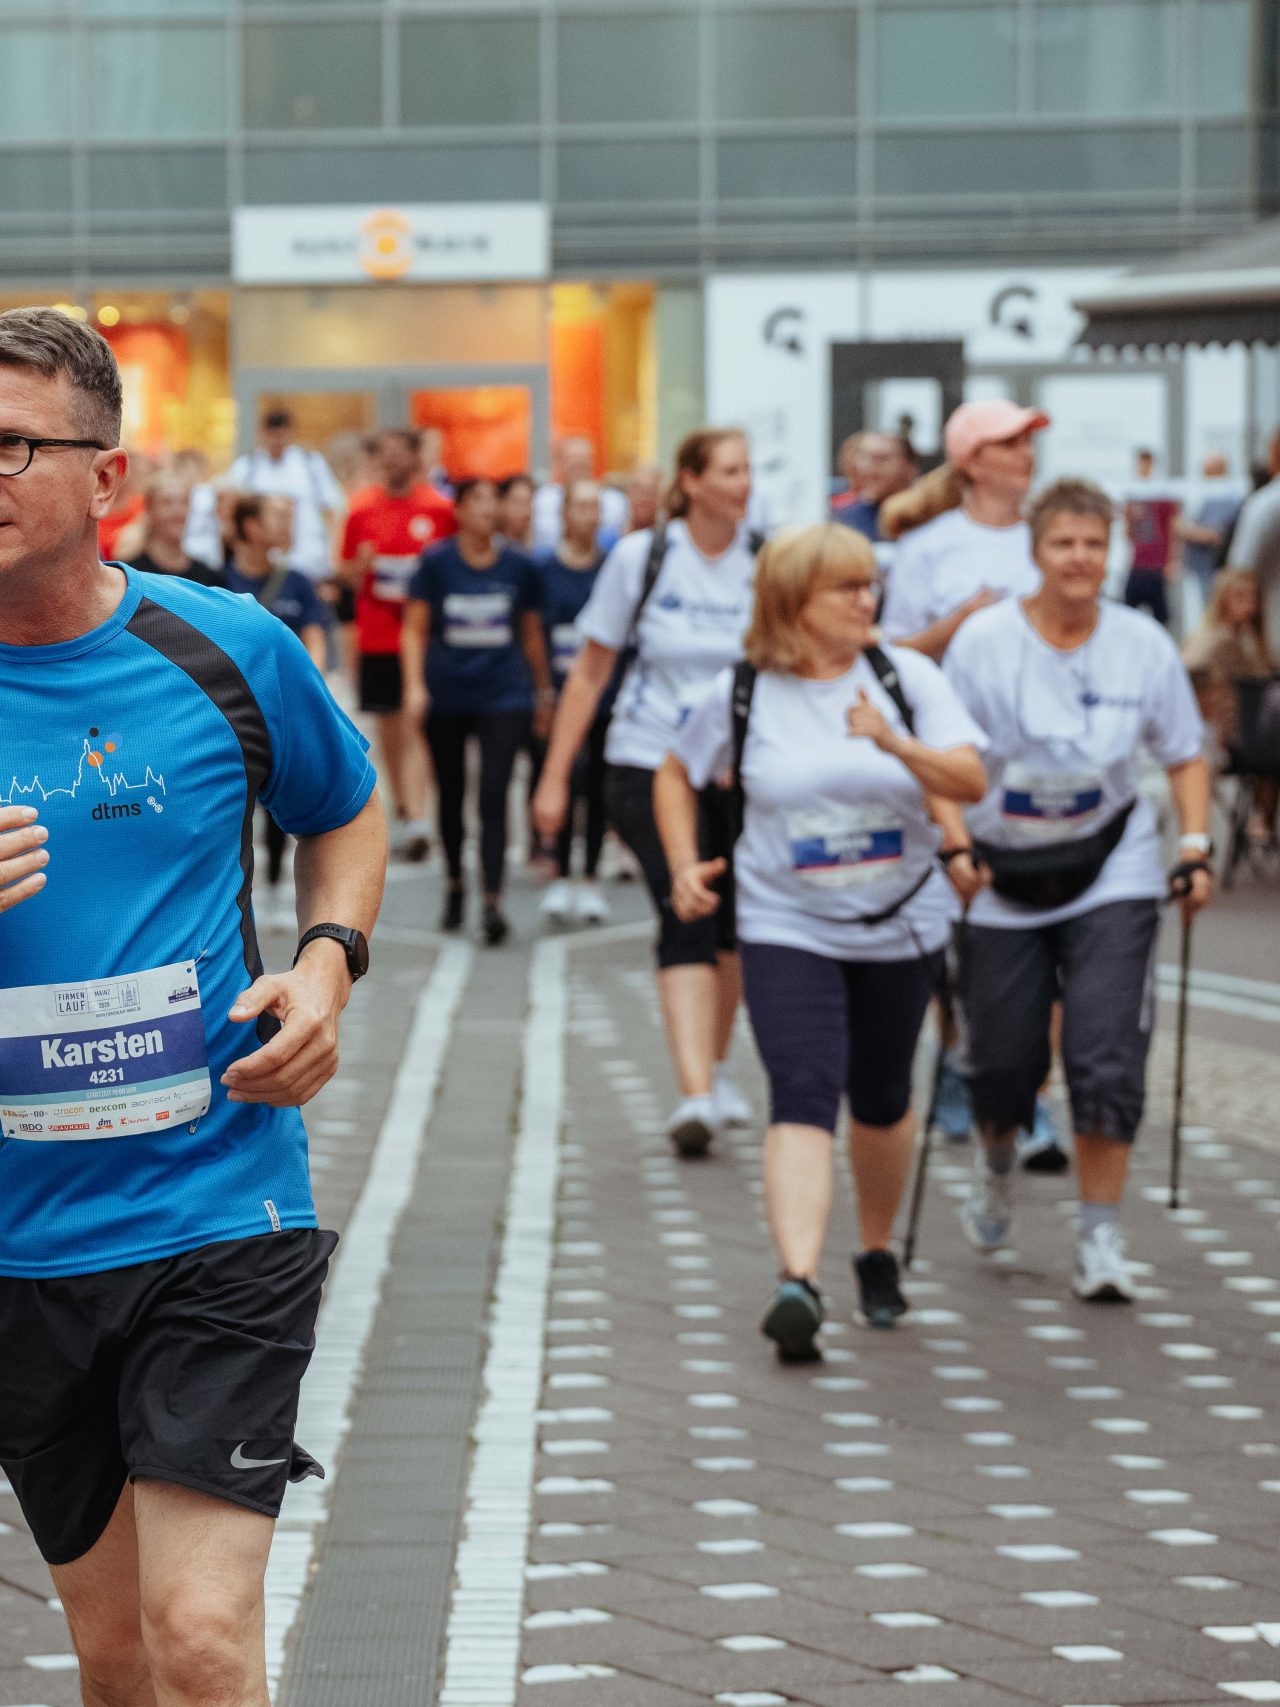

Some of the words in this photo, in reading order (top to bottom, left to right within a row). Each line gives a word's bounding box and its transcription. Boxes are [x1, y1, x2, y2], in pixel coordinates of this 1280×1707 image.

[91, 802, 141, 820] dtms
[58, 991, 85, 1001] FIRMEN
[94, 988, 111, 997] MAINZ
[59, 1000, 86, 1013] LAUF
[40, 1029, 164, 1069] Karsten
[89, 1067, 125, 1084] 4231
[22, 1123, 43, 1131] BDO
[97, 1118, 112, 1127] dm
